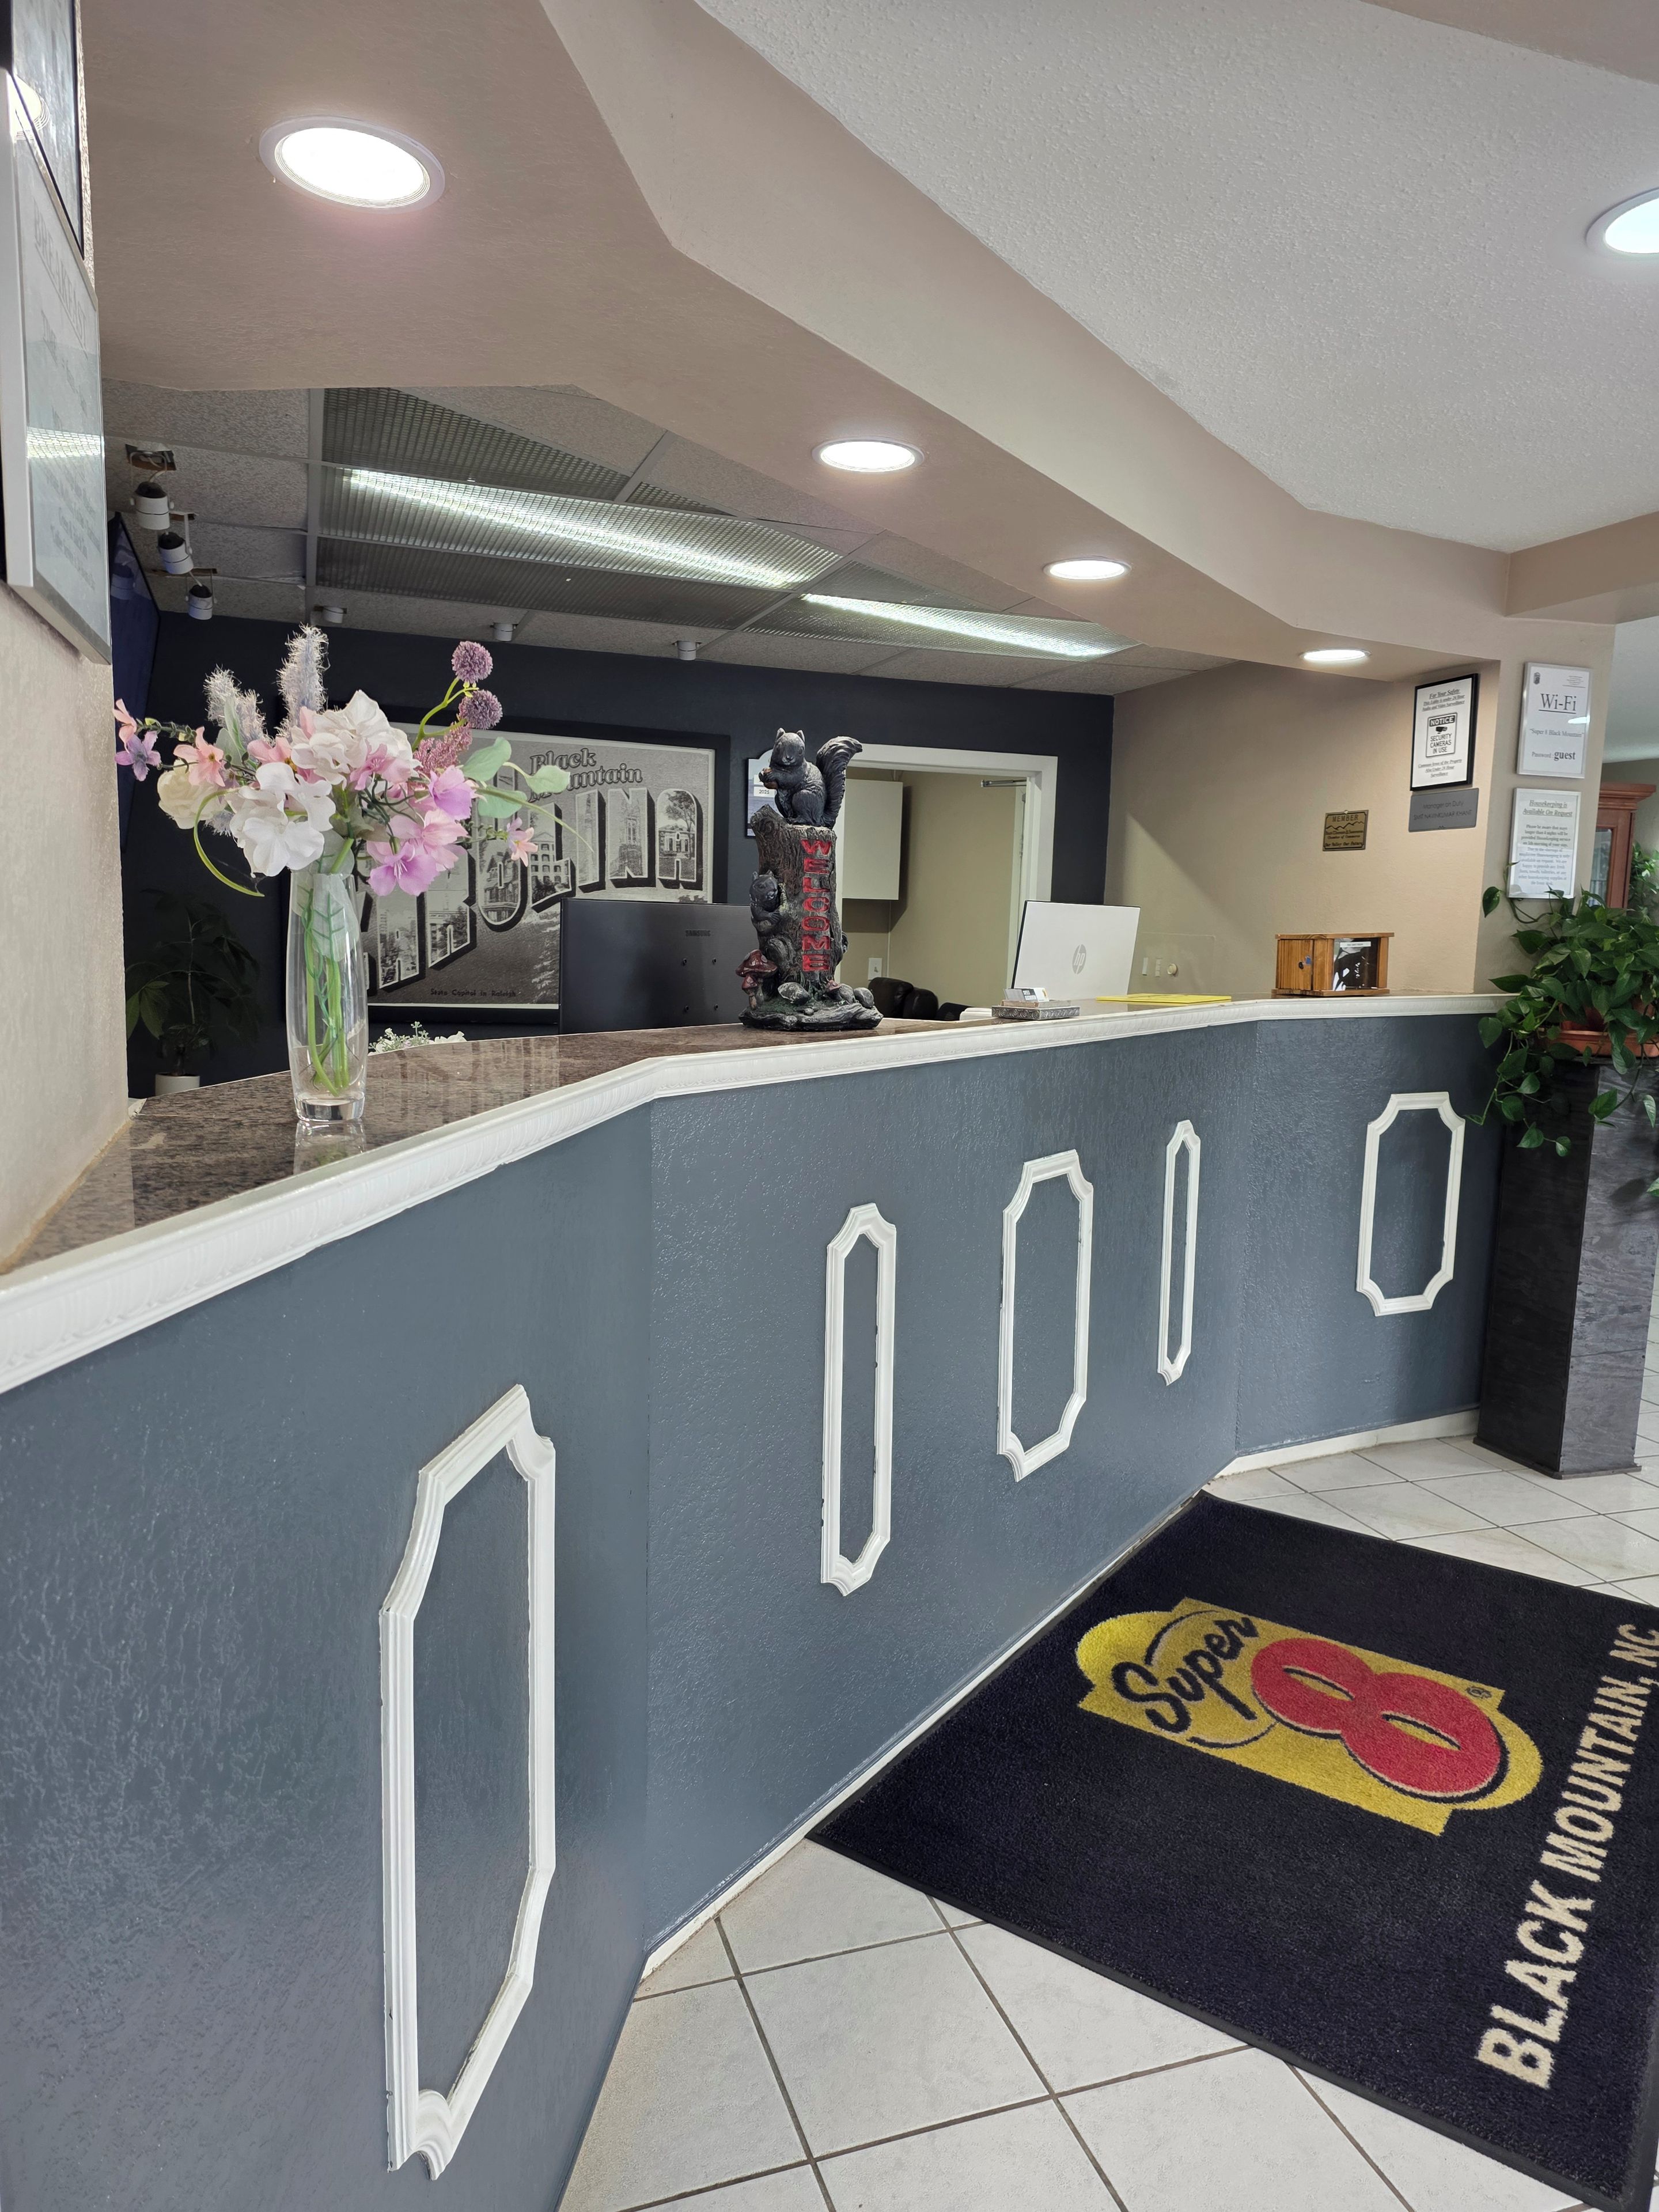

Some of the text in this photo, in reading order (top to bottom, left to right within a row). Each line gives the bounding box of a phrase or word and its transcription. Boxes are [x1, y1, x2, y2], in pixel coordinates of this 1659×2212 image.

[33, 196, 87, 353] BREAKFAST
[1540, 694, 1577, 711] Wi-Fi
[1430, 717, 1454, 726] NOTICE
[1430, 733, 1452, 742] SECURITY
[1430, 740, 1452, 748] CAMERAS
[530, 748, 596, 776] Black
[1554, 752, 1576, 761] guest
[529, 763, 642, 802] untain
[1529, 800, 1563, 808] Housekeeping
[801, 839, 832, 972] WELCOME
[1073, 945, 1086, 975] hp
[431, 988, 448, 996] State
[451, 988, 476, 997] Capitol
[491, 990, 516, 998] Raleigh
[1112, 1616, 1510, 1803] Super 8
[1475, 1623, 1659, 2089] BLACK MOUNTAIN, NC
